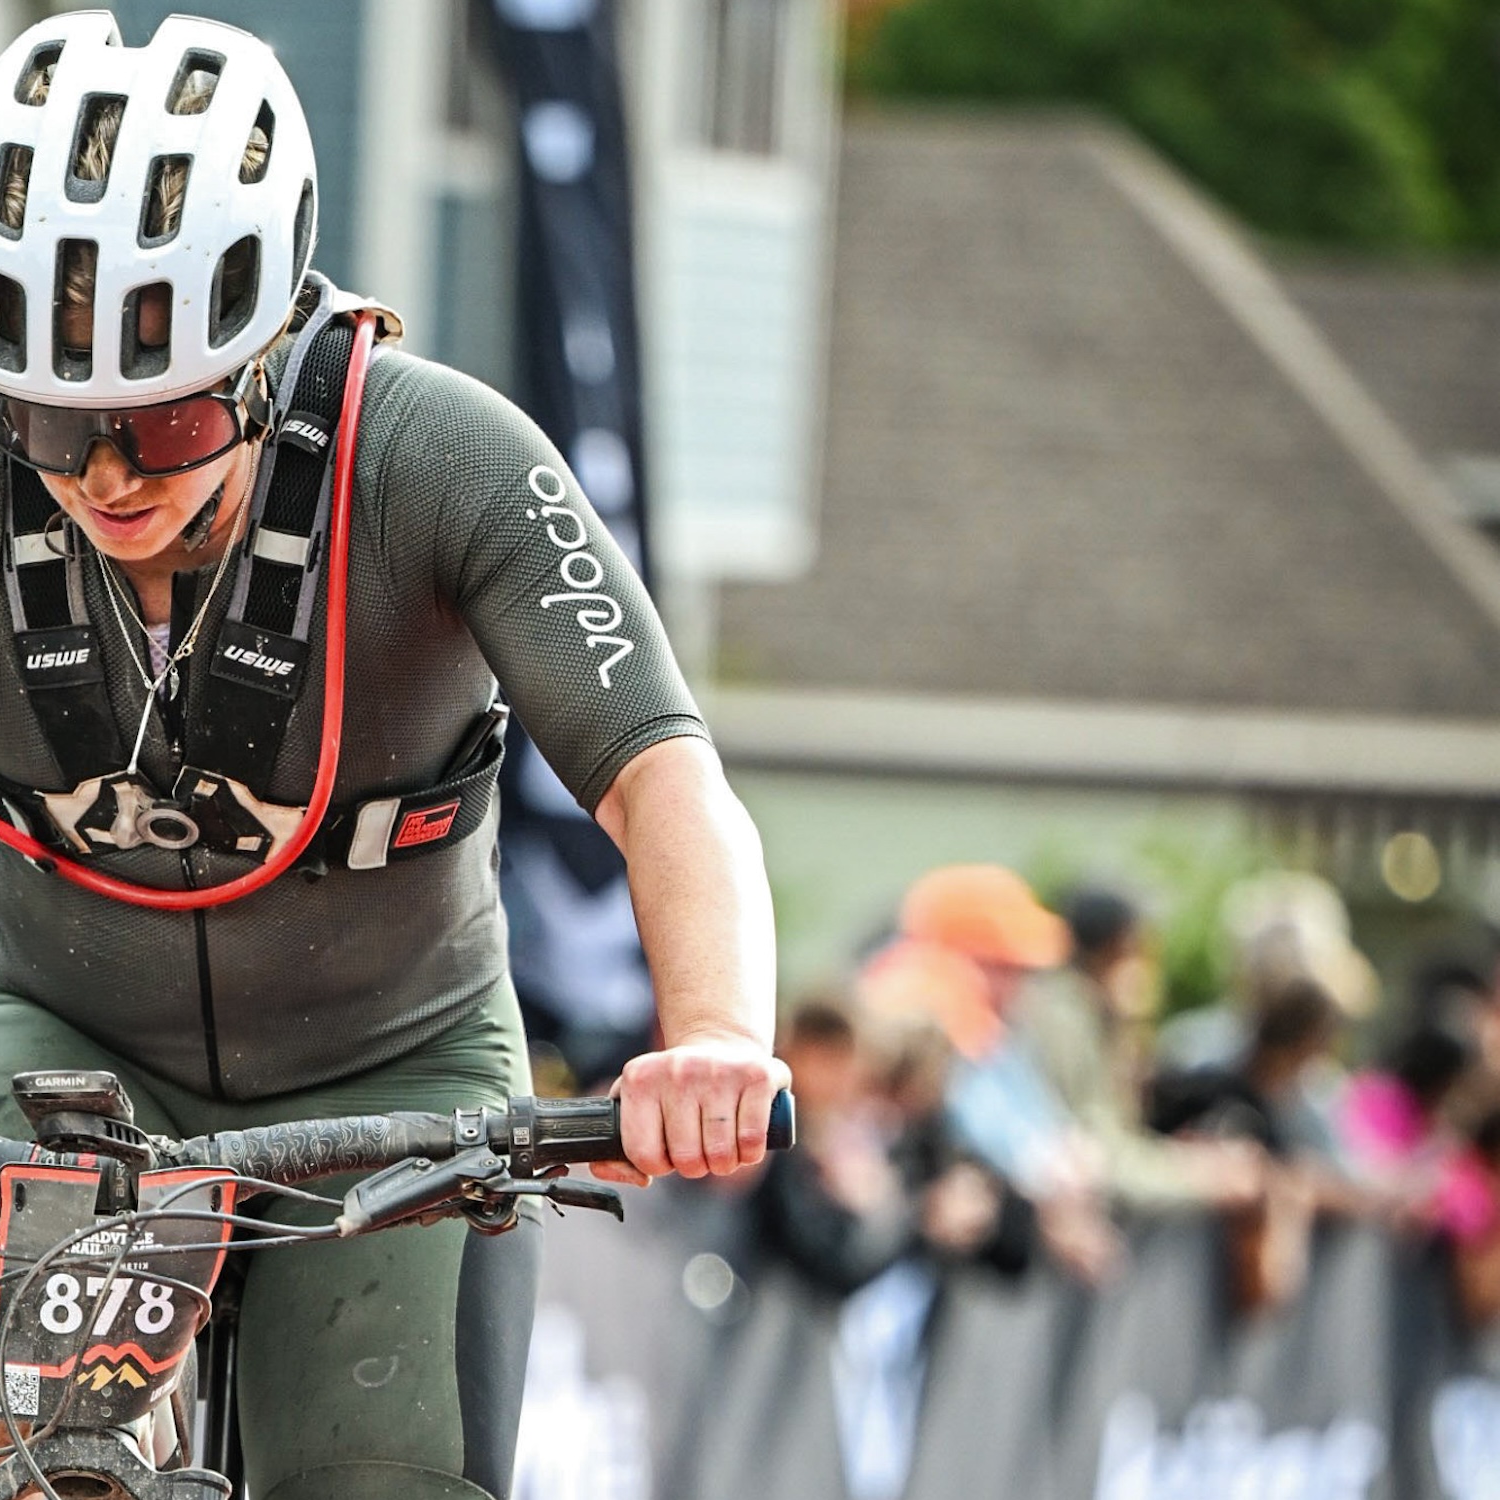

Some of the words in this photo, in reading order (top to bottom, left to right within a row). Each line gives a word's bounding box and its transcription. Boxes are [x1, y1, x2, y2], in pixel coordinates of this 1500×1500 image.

[526, 465, 635, 689] velocio
[26, 648, 90, 670] USWE
[223, 644, 295, 677] USWE
[35, 1077, 86, 1087] GARMIN
[64, 1242, 104, 1256] RAIL
[39, 1273, 175, 1337] 878
